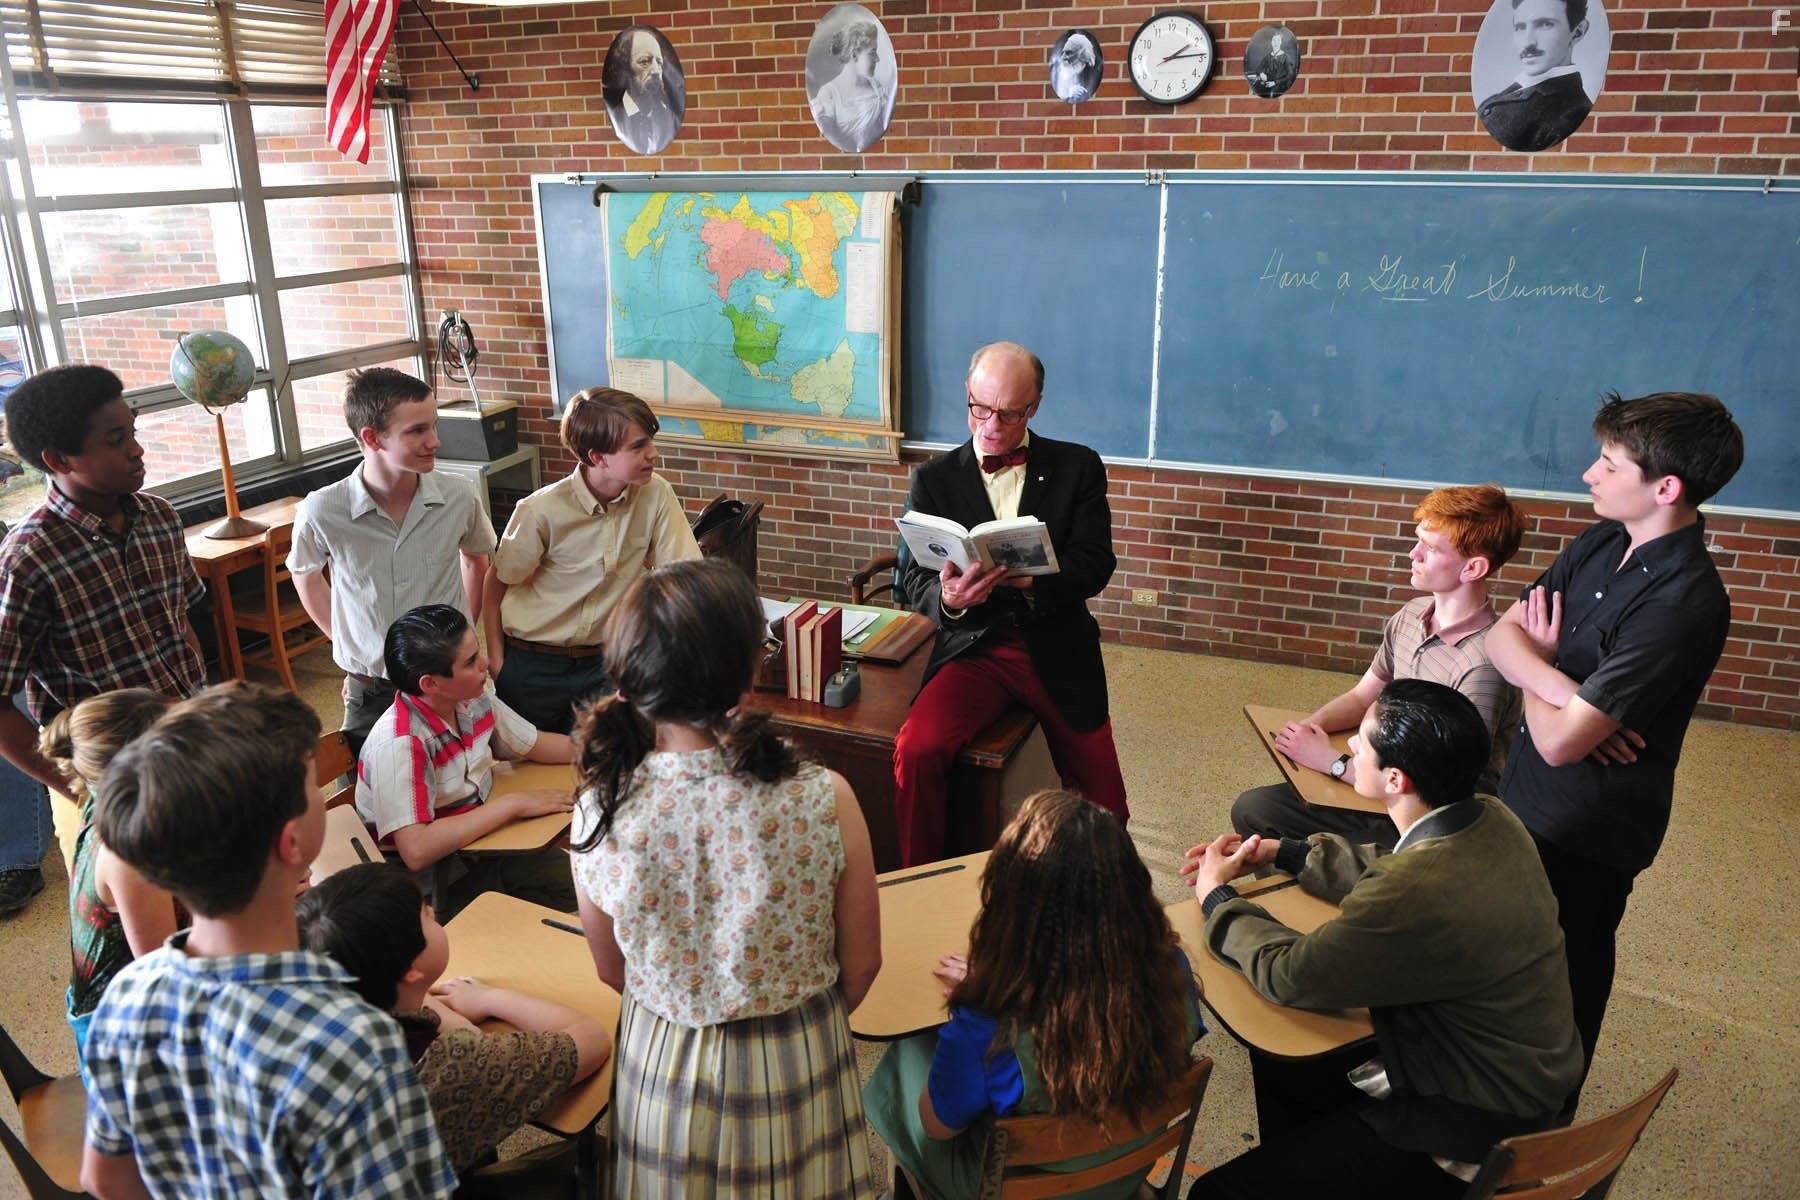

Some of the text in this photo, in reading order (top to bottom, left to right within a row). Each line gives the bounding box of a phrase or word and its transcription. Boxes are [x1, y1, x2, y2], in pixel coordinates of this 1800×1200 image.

[1168, 23, 1176, 32] 12
[1155, 28, 1161, 39] 11
[1143, 39, 1152, 49] 10
[1194, 37, 1200, 47] 2
[1138, 54, 1143, 63] 9
[1198, 55, 1203, 63] 3
[1191, 68, 1197, 77] 4
[1153, 80, 1158, 89] 7
[1166, 84, 1172, 93] 6
[1181, 79, 1186, 89] 5
[1259, 248, 1321, 290] Have
[1337, 271, 1351, 289] a
[1362, 254, 1457, 295] Great
[1466, 255, 1612, 303] Summer
